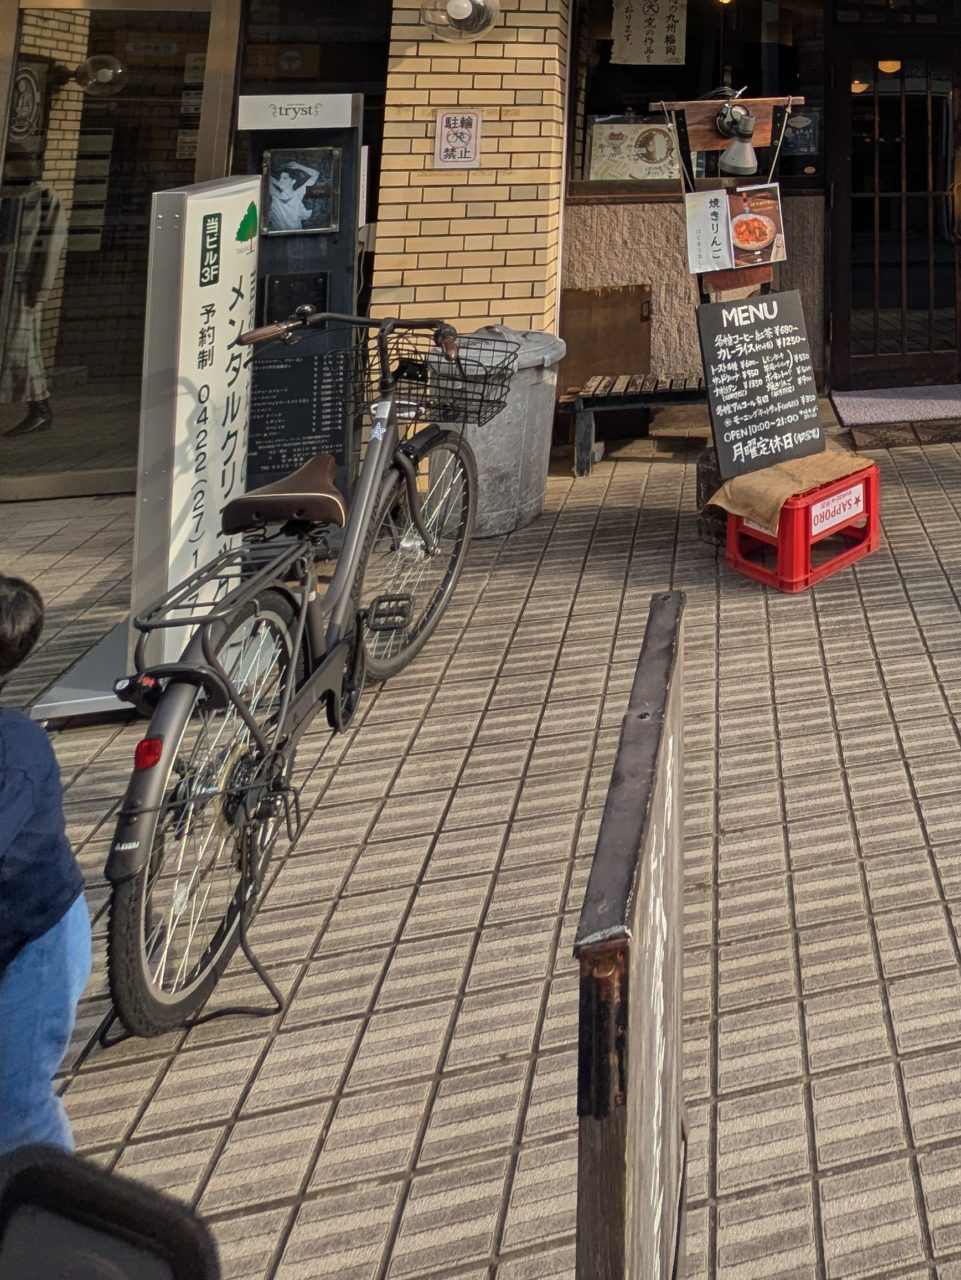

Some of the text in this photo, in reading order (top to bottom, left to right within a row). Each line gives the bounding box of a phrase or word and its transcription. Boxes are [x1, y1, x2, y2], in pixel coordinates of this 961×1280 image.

[278, 105, 313, 120] tryst
[444, 116, 473, 129] 駐輪
[443, 147, 472, 159] 禁止
[709, 198, 722, 259] 焼きりんご
[201, 217, 220, 283] 当ビル3F
[721, 301, 778, 327] MENU
[197, 303, 216, 369] 予約制
[813, 498, 853, 526] SAPPORO
